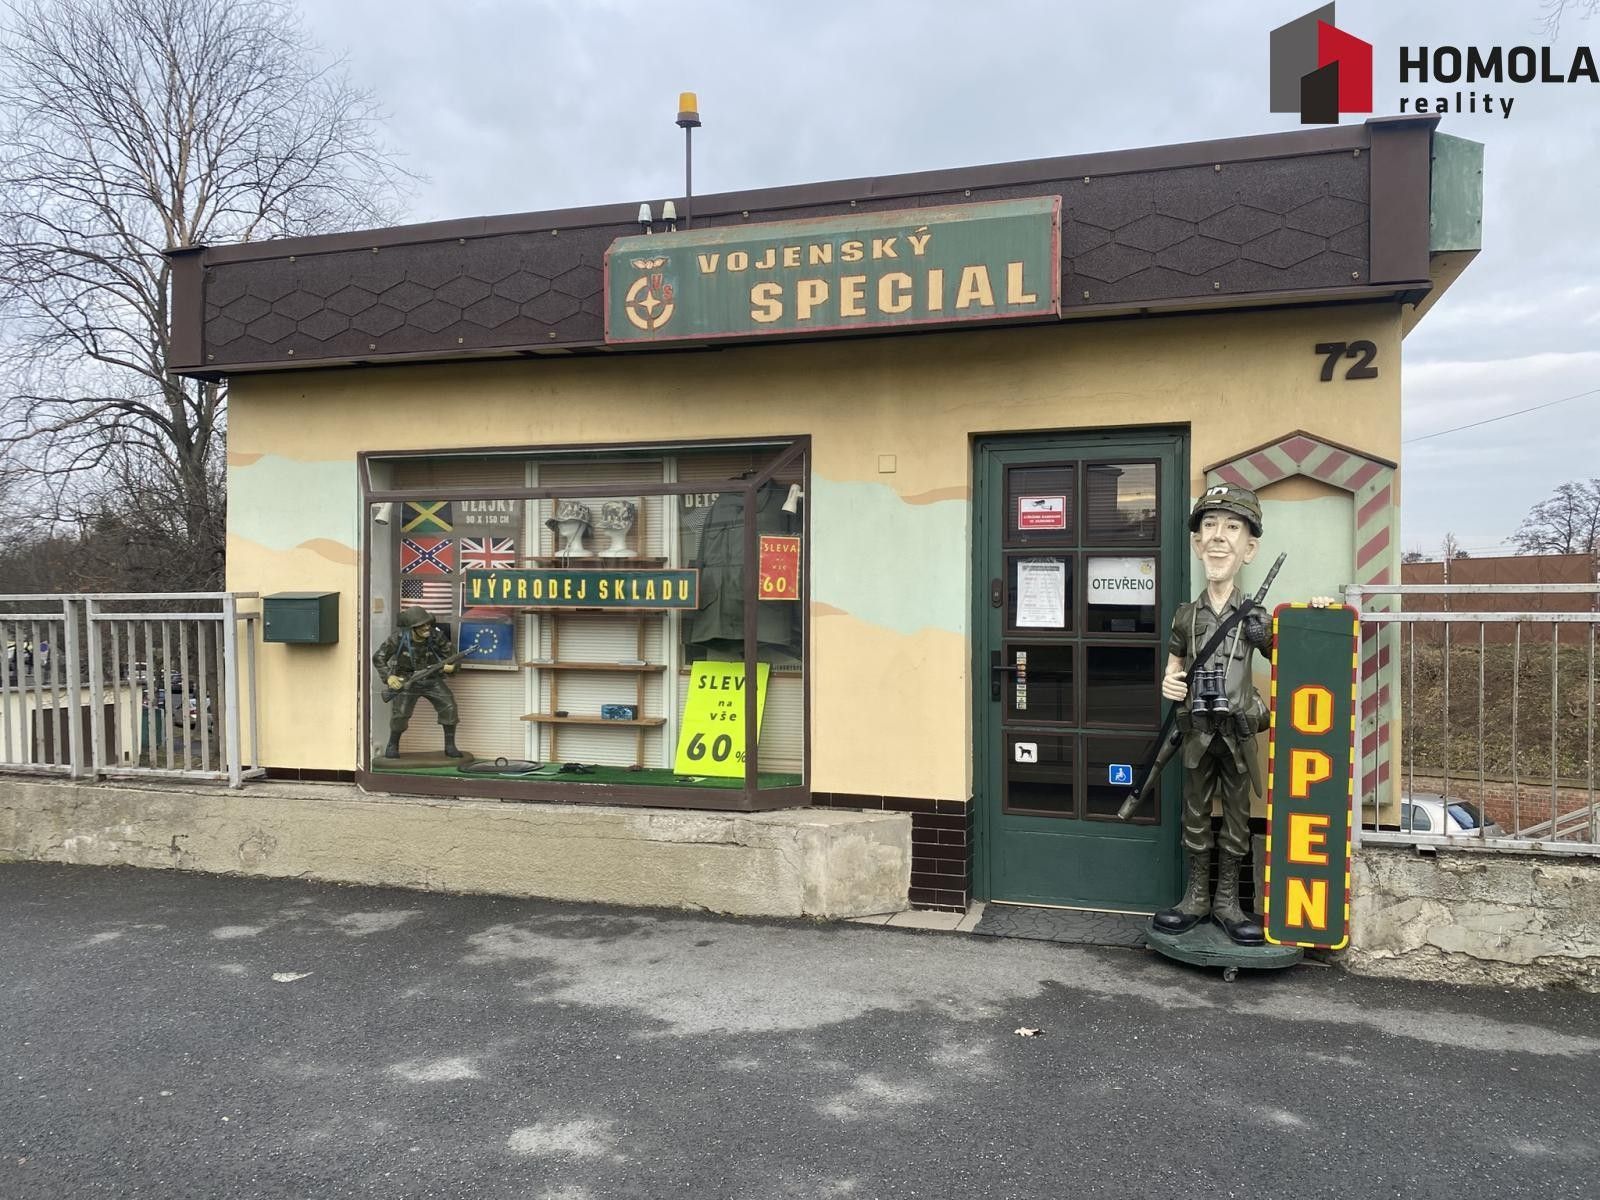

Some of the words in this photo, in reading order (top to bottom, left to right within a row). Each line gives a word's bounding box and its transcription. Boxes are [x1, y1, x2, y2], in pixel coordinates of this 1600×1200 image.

[697, 226, 931, 274] VOJENSKÝ
[750, 261, 1037, 323] SPECIAL
[1315, 340, 1378, 382] 72
[764, 543, 796, 552] SLEVA
[472, 573, 586, 599] VÝPRODEJ
[599, 579, 689, 600] SKLADU
[1092, 576, 1154, 590] OTEVŘENO
[698, 675, 746, 690] SLEV
[710, 711, 737, 721] vše
[1284, 684, 1334, 930] OPEN
